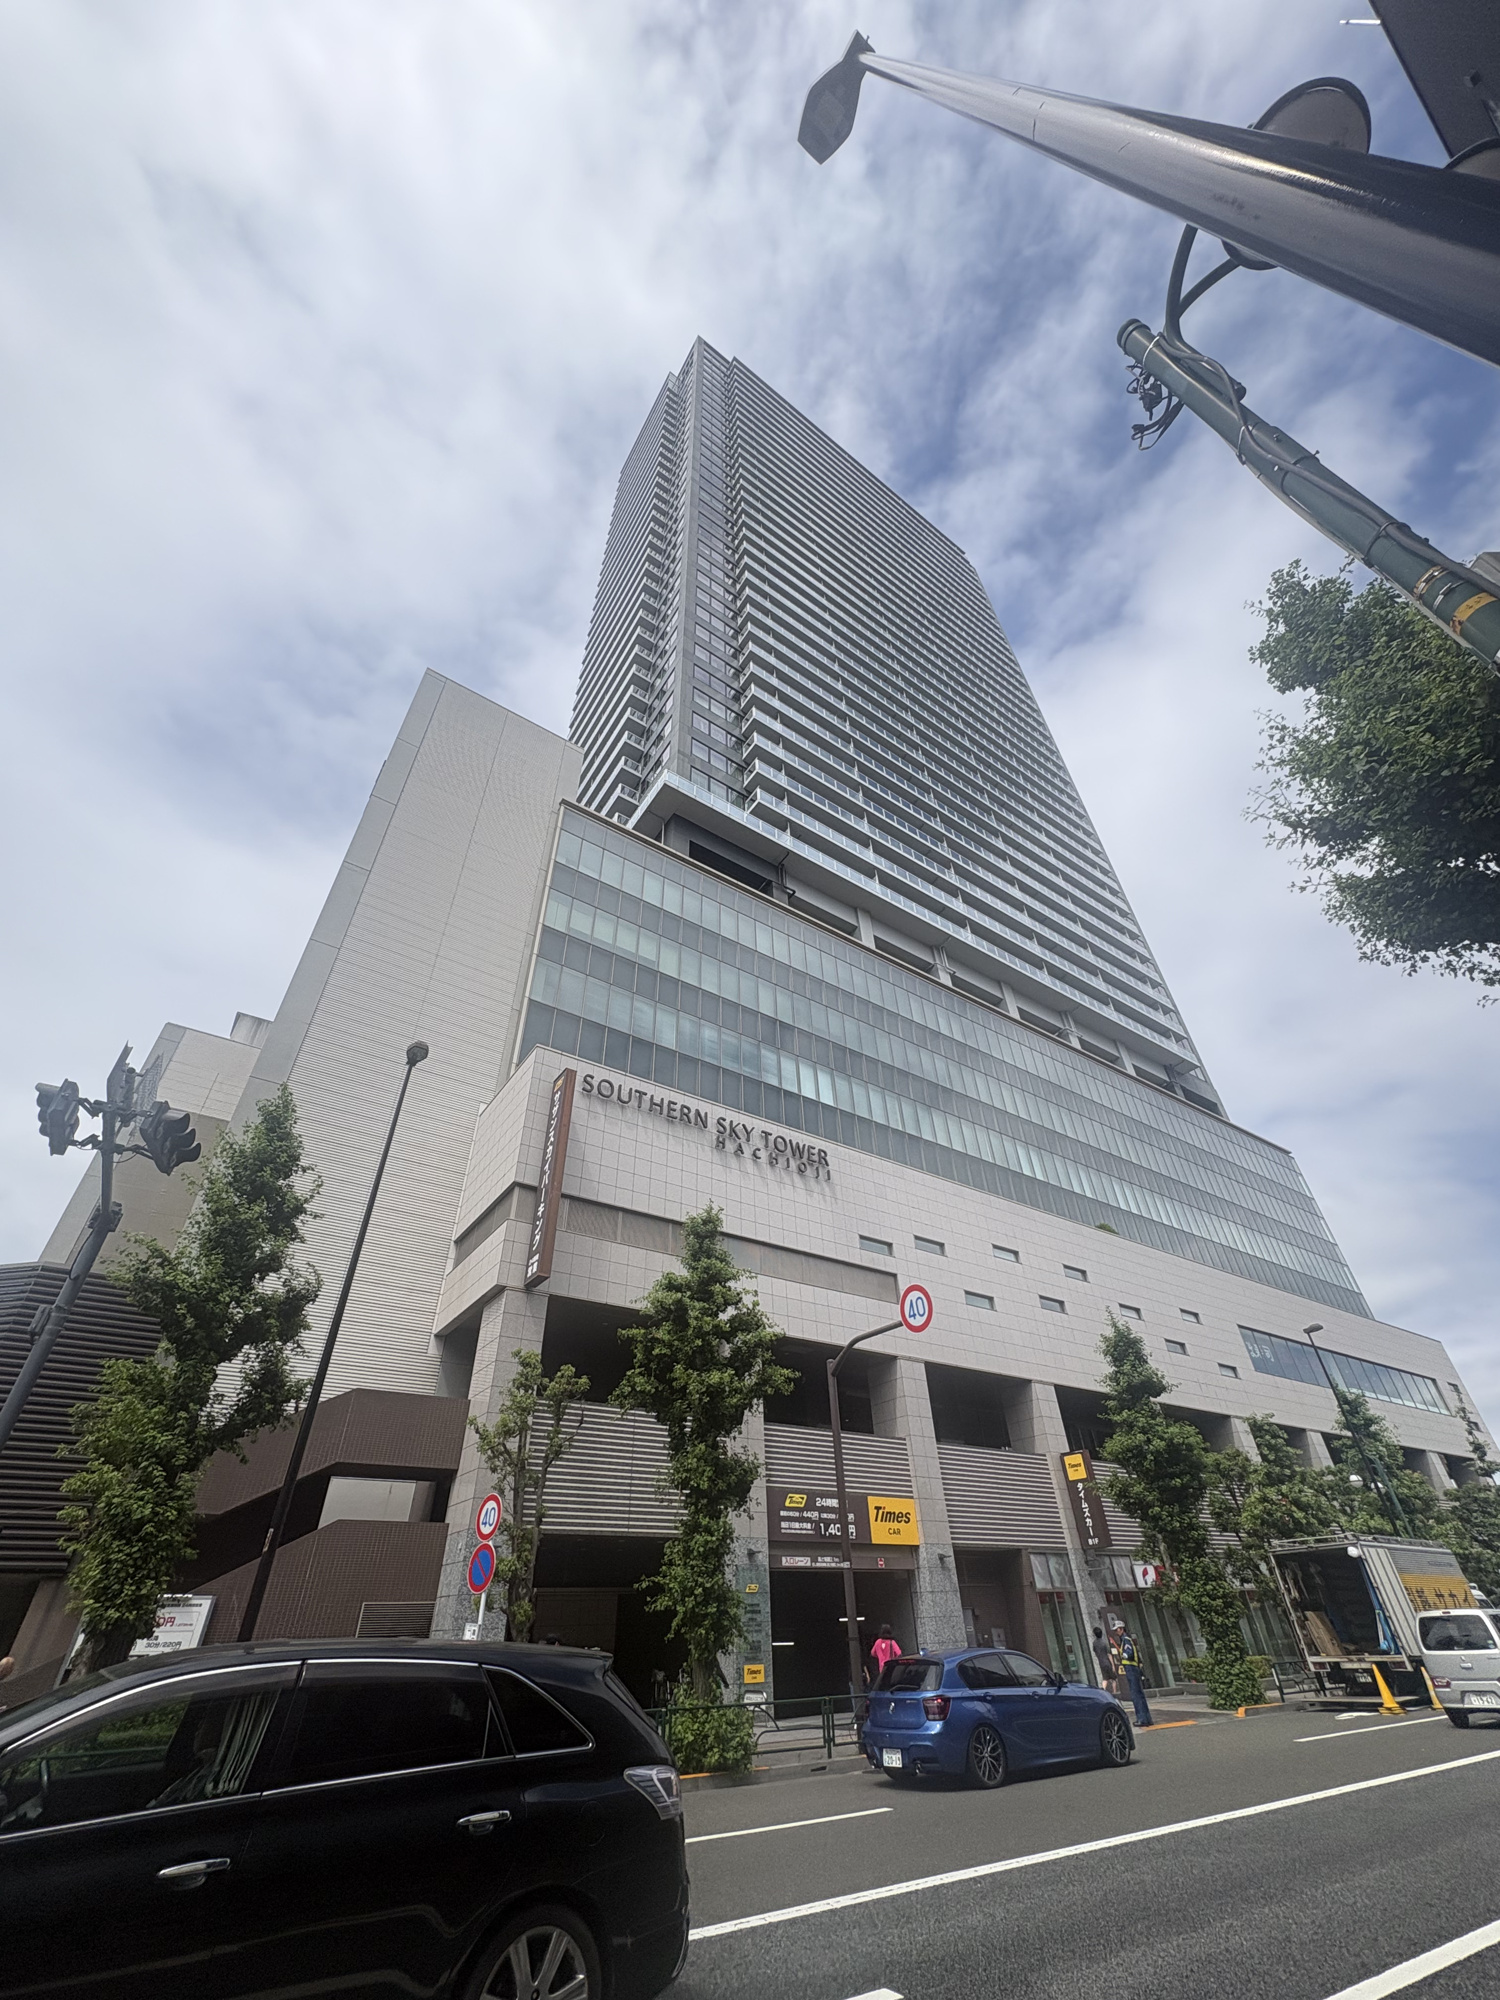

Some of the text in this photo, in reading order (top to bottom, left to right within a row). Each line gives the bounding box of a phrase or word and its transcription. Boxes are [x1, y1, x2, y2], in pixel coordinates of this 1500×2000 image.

[581, 1073, 709, 1129] SOUTHERN
[716, 1116, 756, 1142] SKY
[760, 1130, 831, 1167] TOWER
[714, 1135, 832, 1181] HACHIOJI
[908, 1296, 926, 1320] 40
[481, 1507, 497, 1528] 40
[873, 1505, 912, 1525] Times
[1077, 1482, 1093, 1537] タイムズカー
[887, 1528, 902, 1536] CAR
[784, 1557, 809, 1565] 入口レーン
